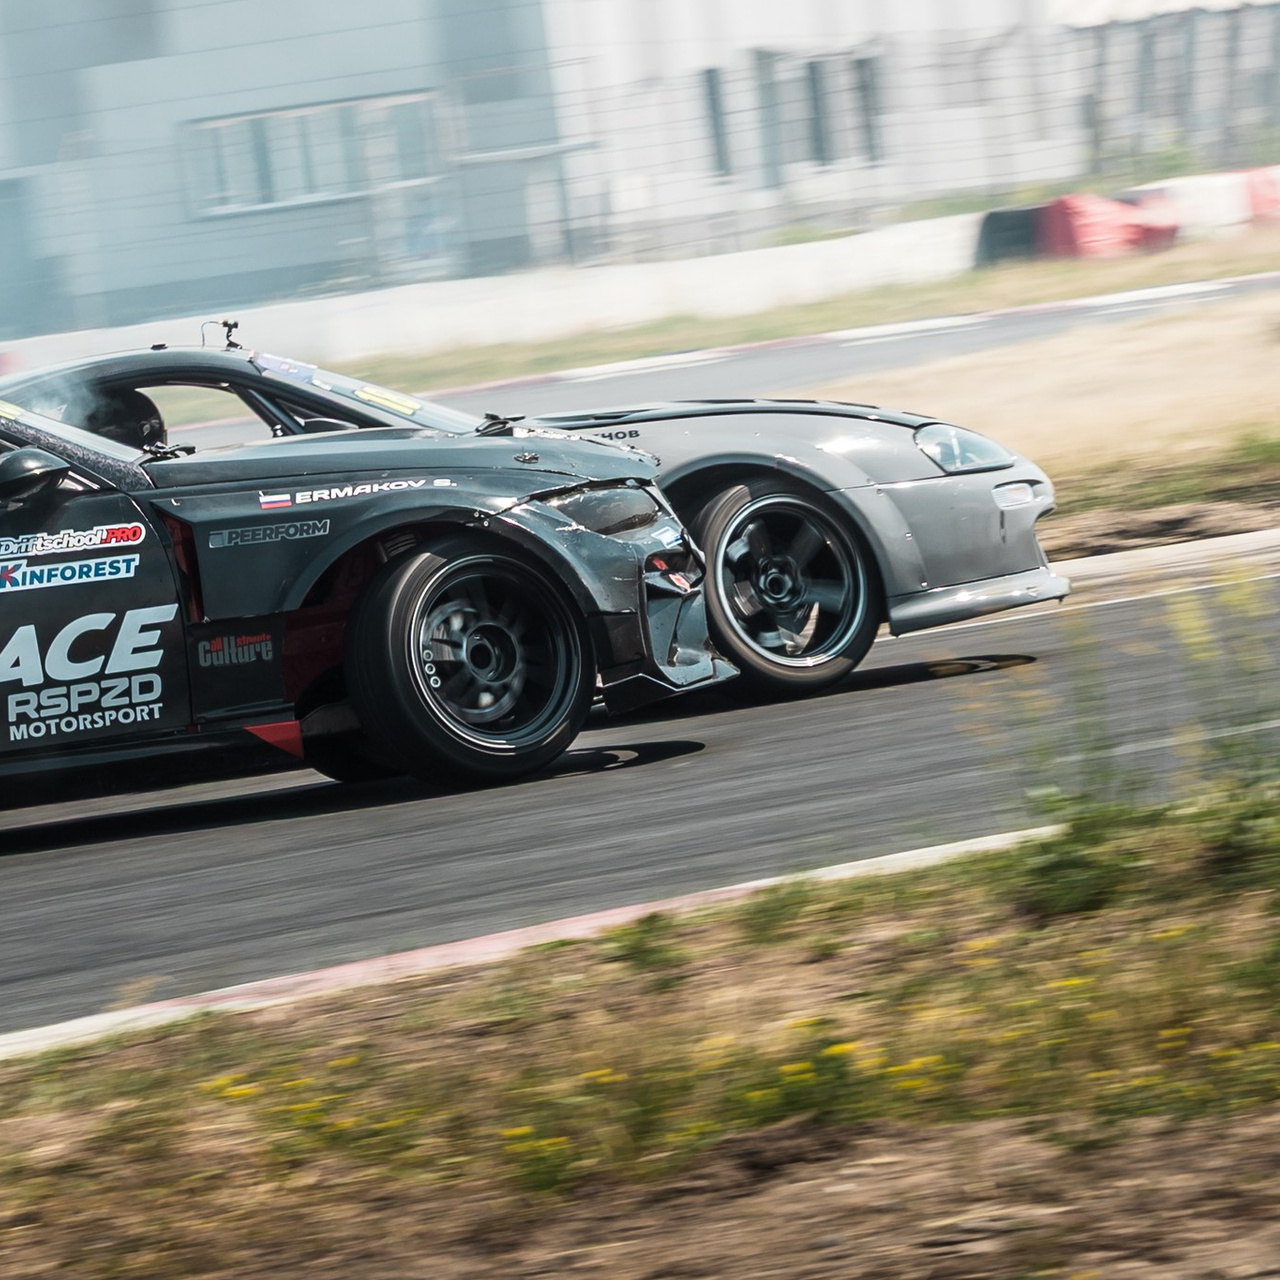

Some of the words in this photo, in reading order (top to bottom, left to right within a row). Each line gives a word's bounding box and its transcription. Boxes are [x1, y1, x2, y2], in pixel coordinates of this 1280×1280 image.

[295, 479, 426, 505] ERMAKOV
[433, 478, 458, 487] S.
[227, 521, 328, 545] PEERFORM
[198, 636, 273, 667] Culture
[8, 673, 162, 722] RSPZD
[9, 703, 163, 741] MOTORSPORT
